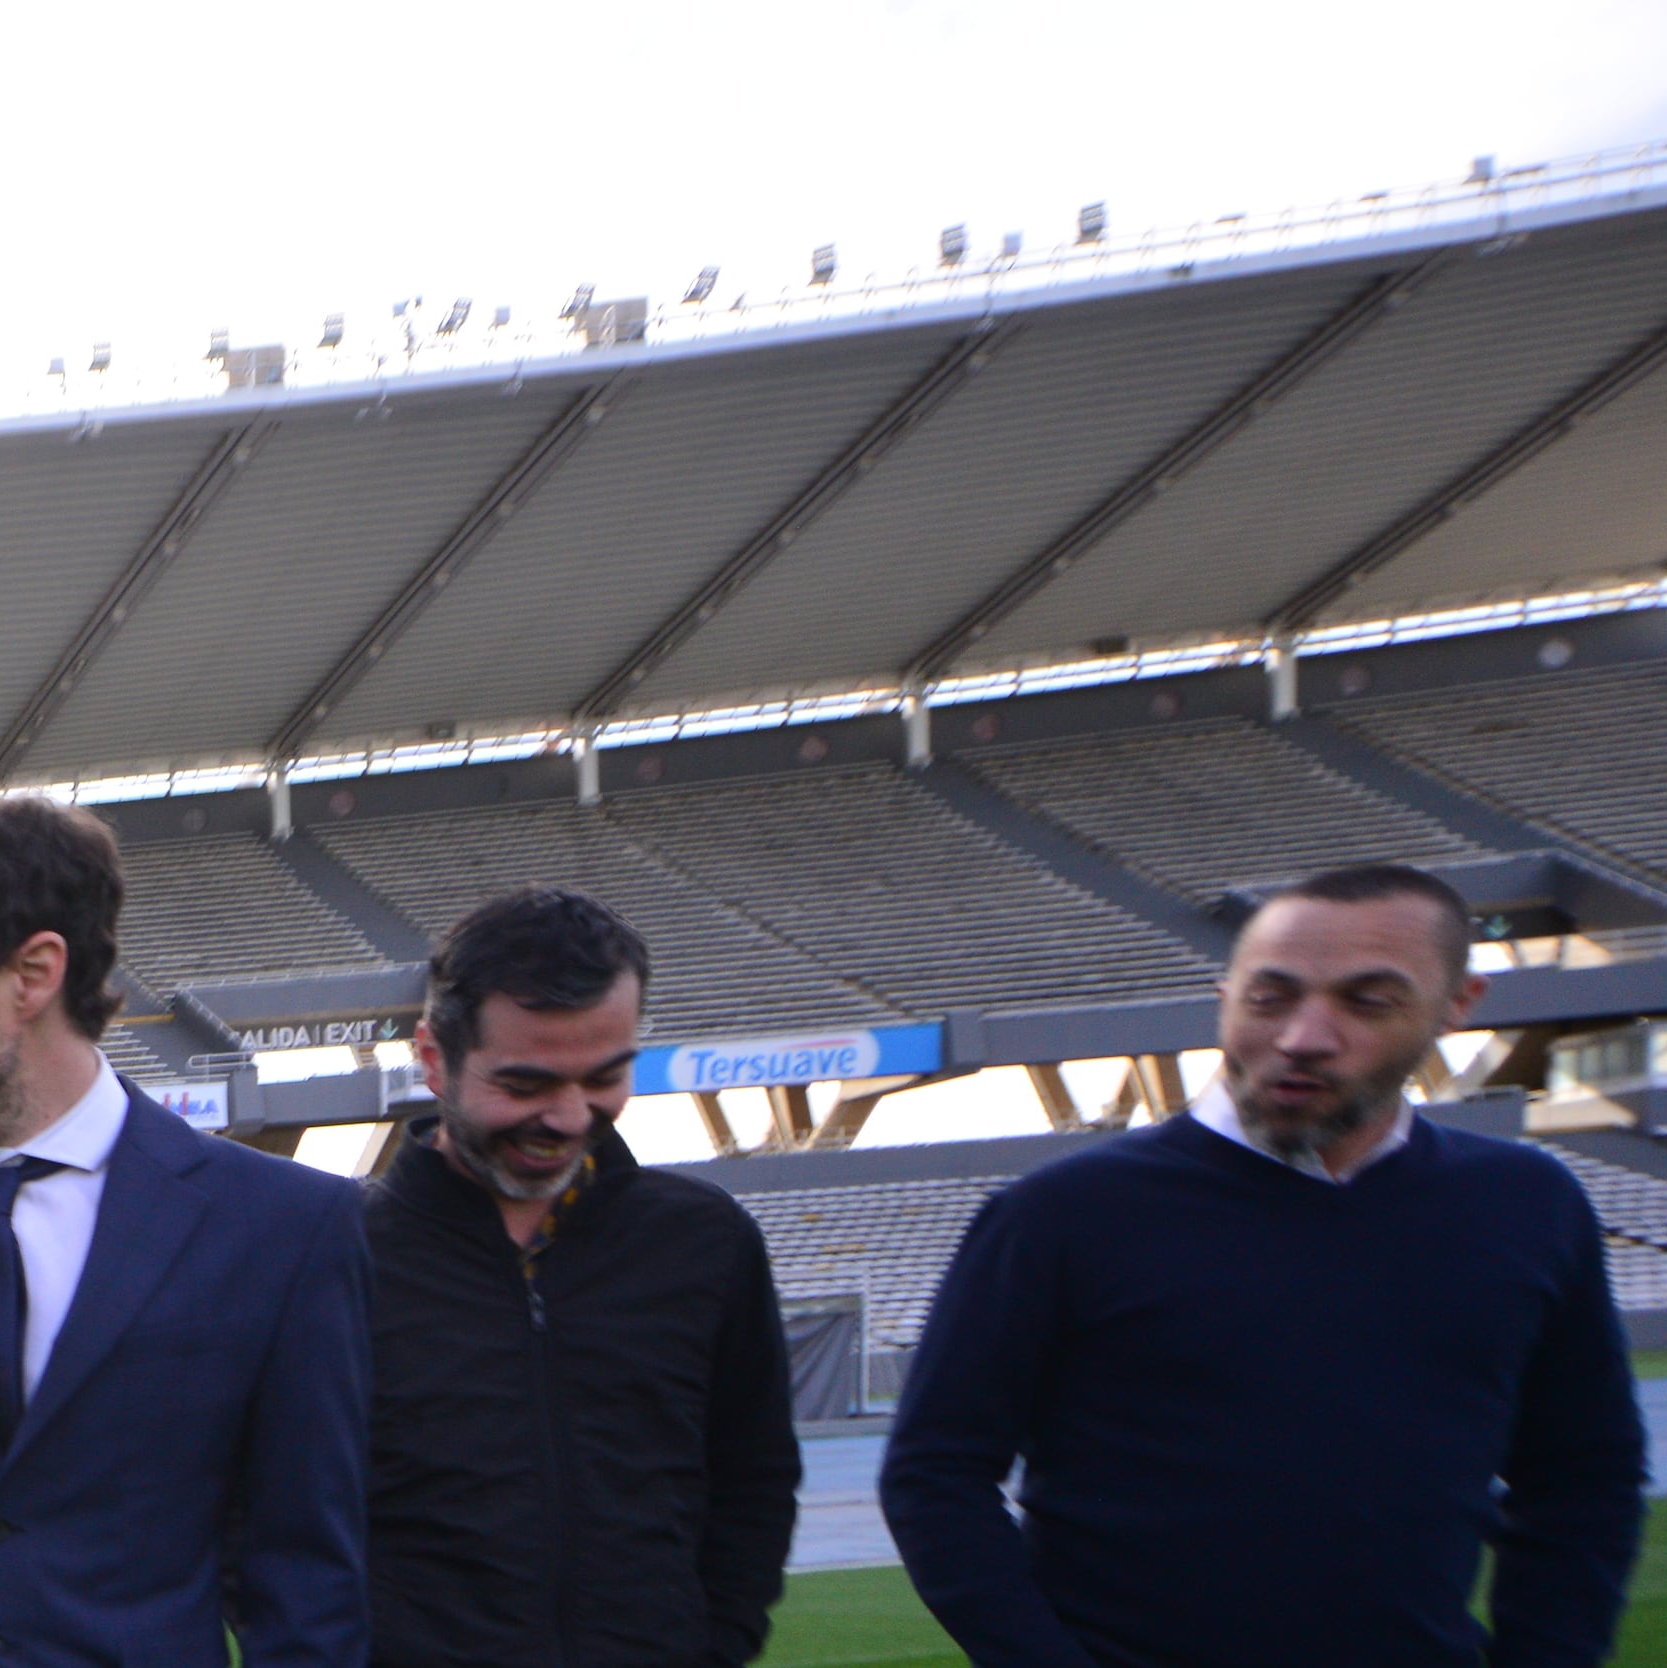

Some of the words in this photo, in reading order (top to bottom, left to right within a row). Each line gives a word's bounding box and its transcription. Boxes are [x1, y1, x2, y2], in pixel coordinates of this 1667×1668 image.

[239, 1024, 312, 1050] ALIDA
[324, 1019, 377, 1044] EXIT
[688, 1046, 857, 1085] Tersuave
